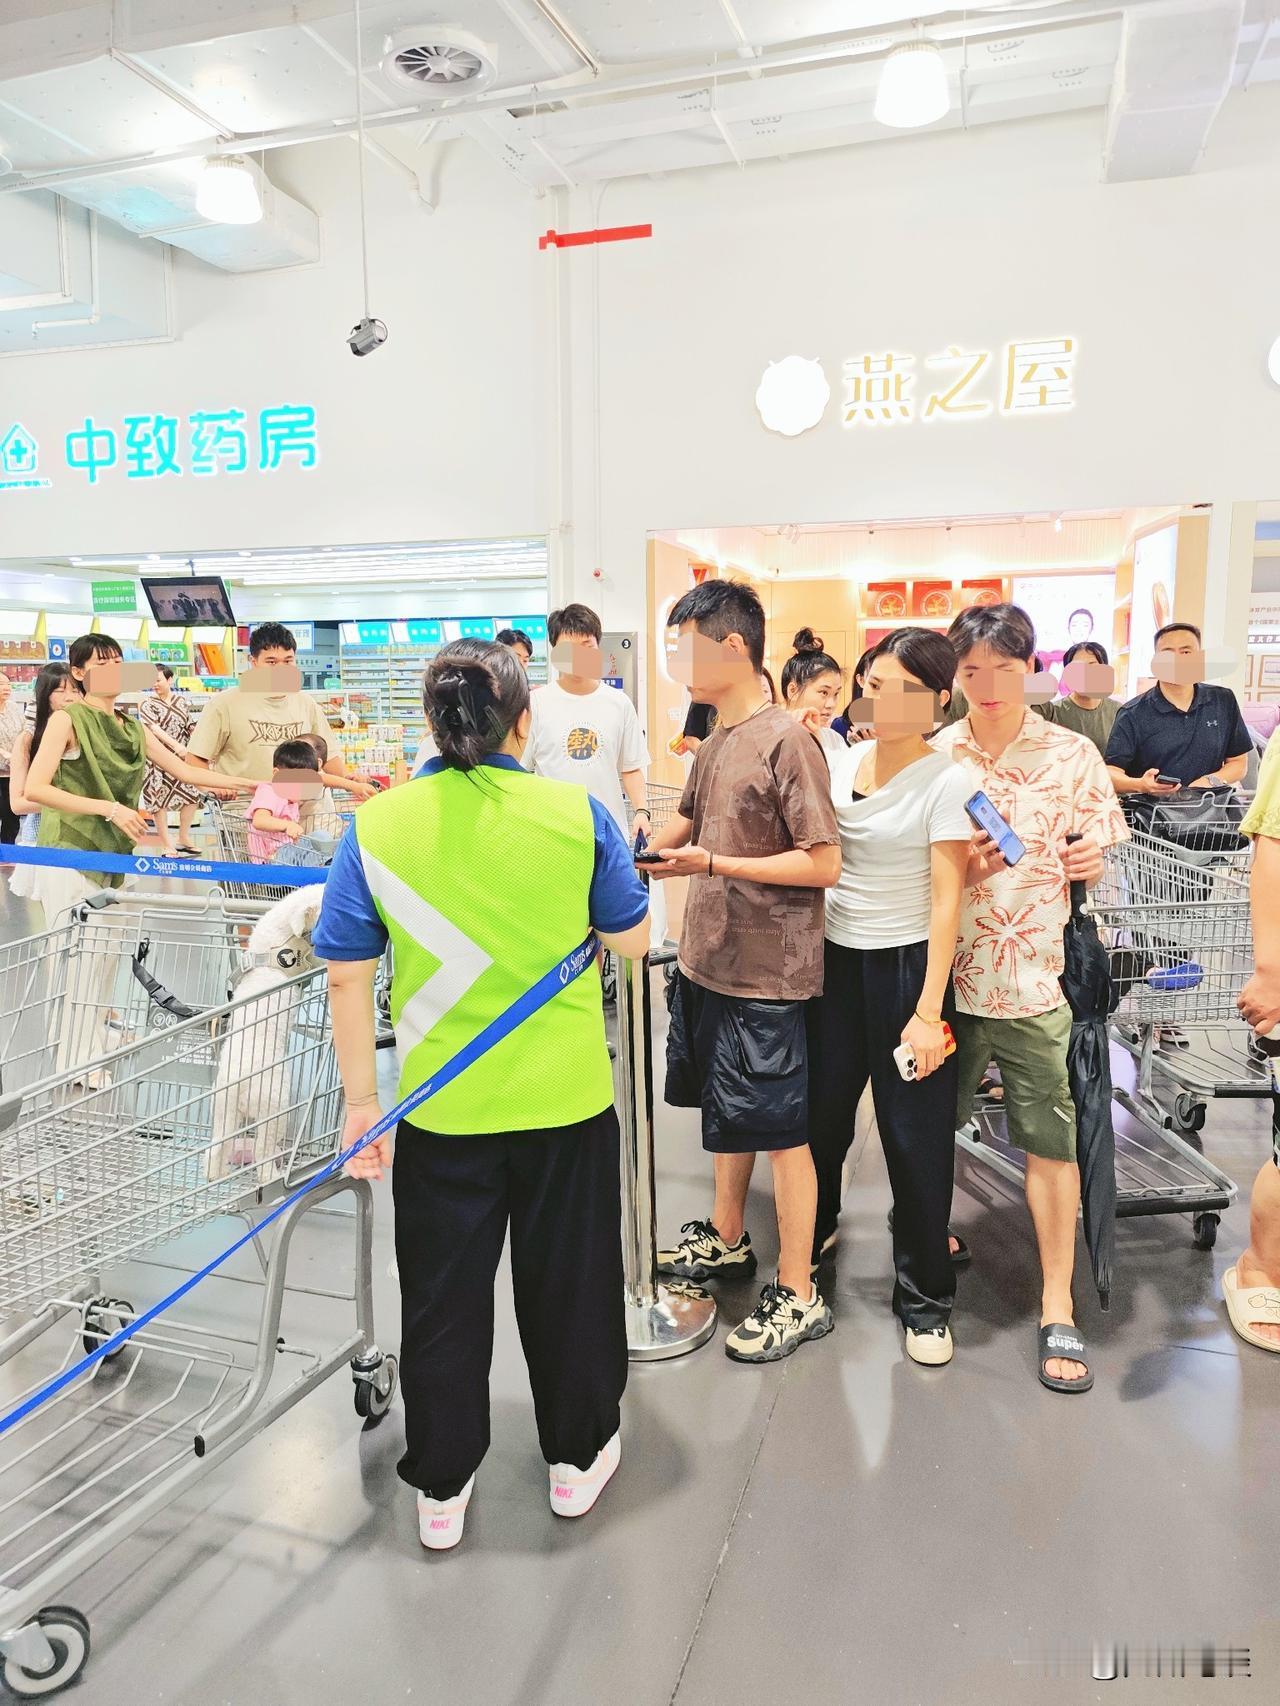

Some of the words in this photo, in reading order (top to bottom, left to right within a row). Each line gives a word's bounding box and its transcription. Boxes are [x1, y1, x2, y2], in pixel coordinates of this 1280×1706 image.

[843, 338, 1073, 423] 燕之屋
[65, 404, 316, 483] 中致药房
[1046, 1335, 1084, 1352] Super
[554, 1485, 576, 1499] NIKE
[429, 1518, 452, 1530] NIKE
